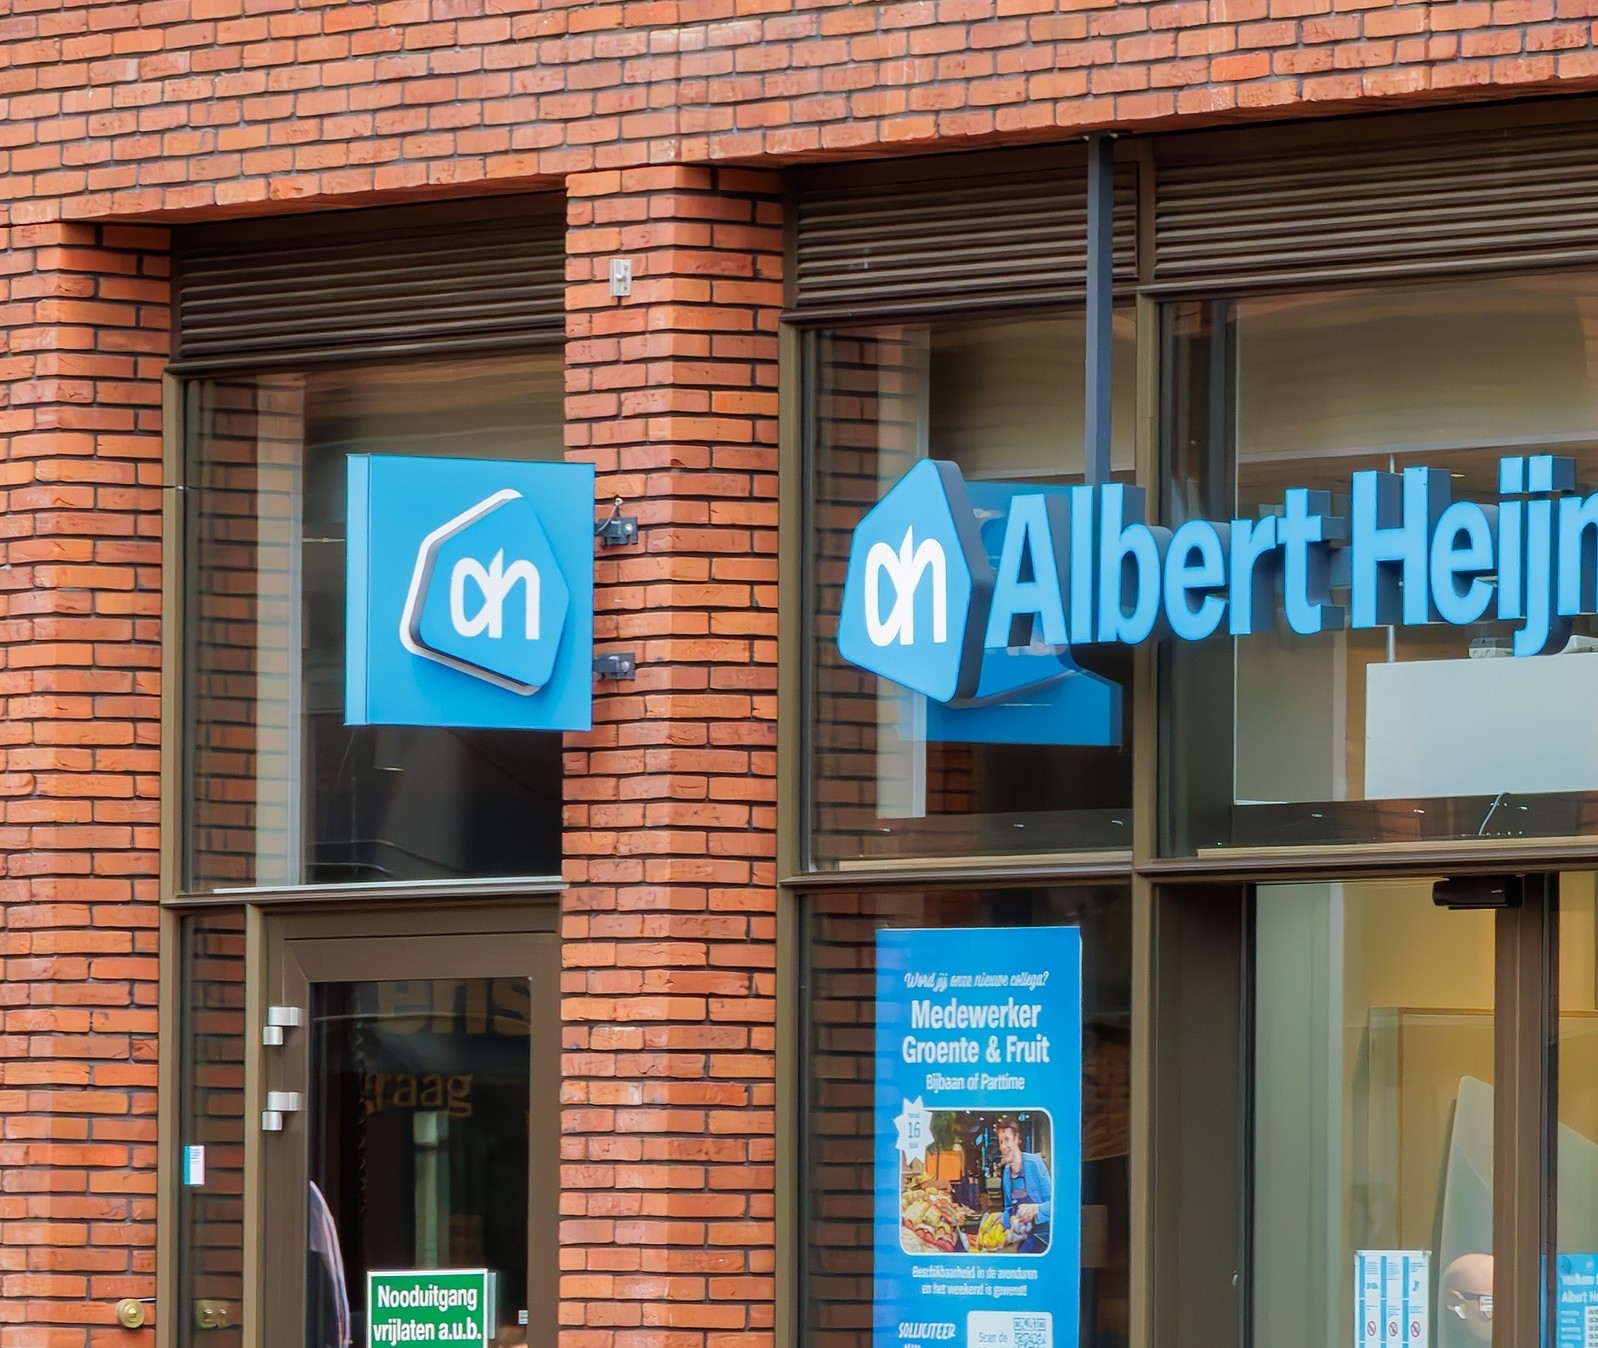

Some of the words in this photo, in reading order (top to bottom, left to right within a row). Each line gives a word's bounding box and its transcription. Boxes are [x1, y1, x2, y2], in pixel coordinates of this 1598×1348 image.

[984, 482, 1325, 648] Albert
[911, 997, 1041, 1029] Medewerker
[903, 1036, 979, 1064] Groente
[986, 1035, 1001, 1063] &
[1006, 1034, 1050, 1063] Fruit
[907, 1122, 921, 1139] 16
[378, 1285, 477, 1311] Nooduitgang
[373, 1318, 434, 1346] vrijlaten
[438, 1317, 481, 1340] a.u.b.
[899, 1323, 956, 1339] SOLLICITEER
